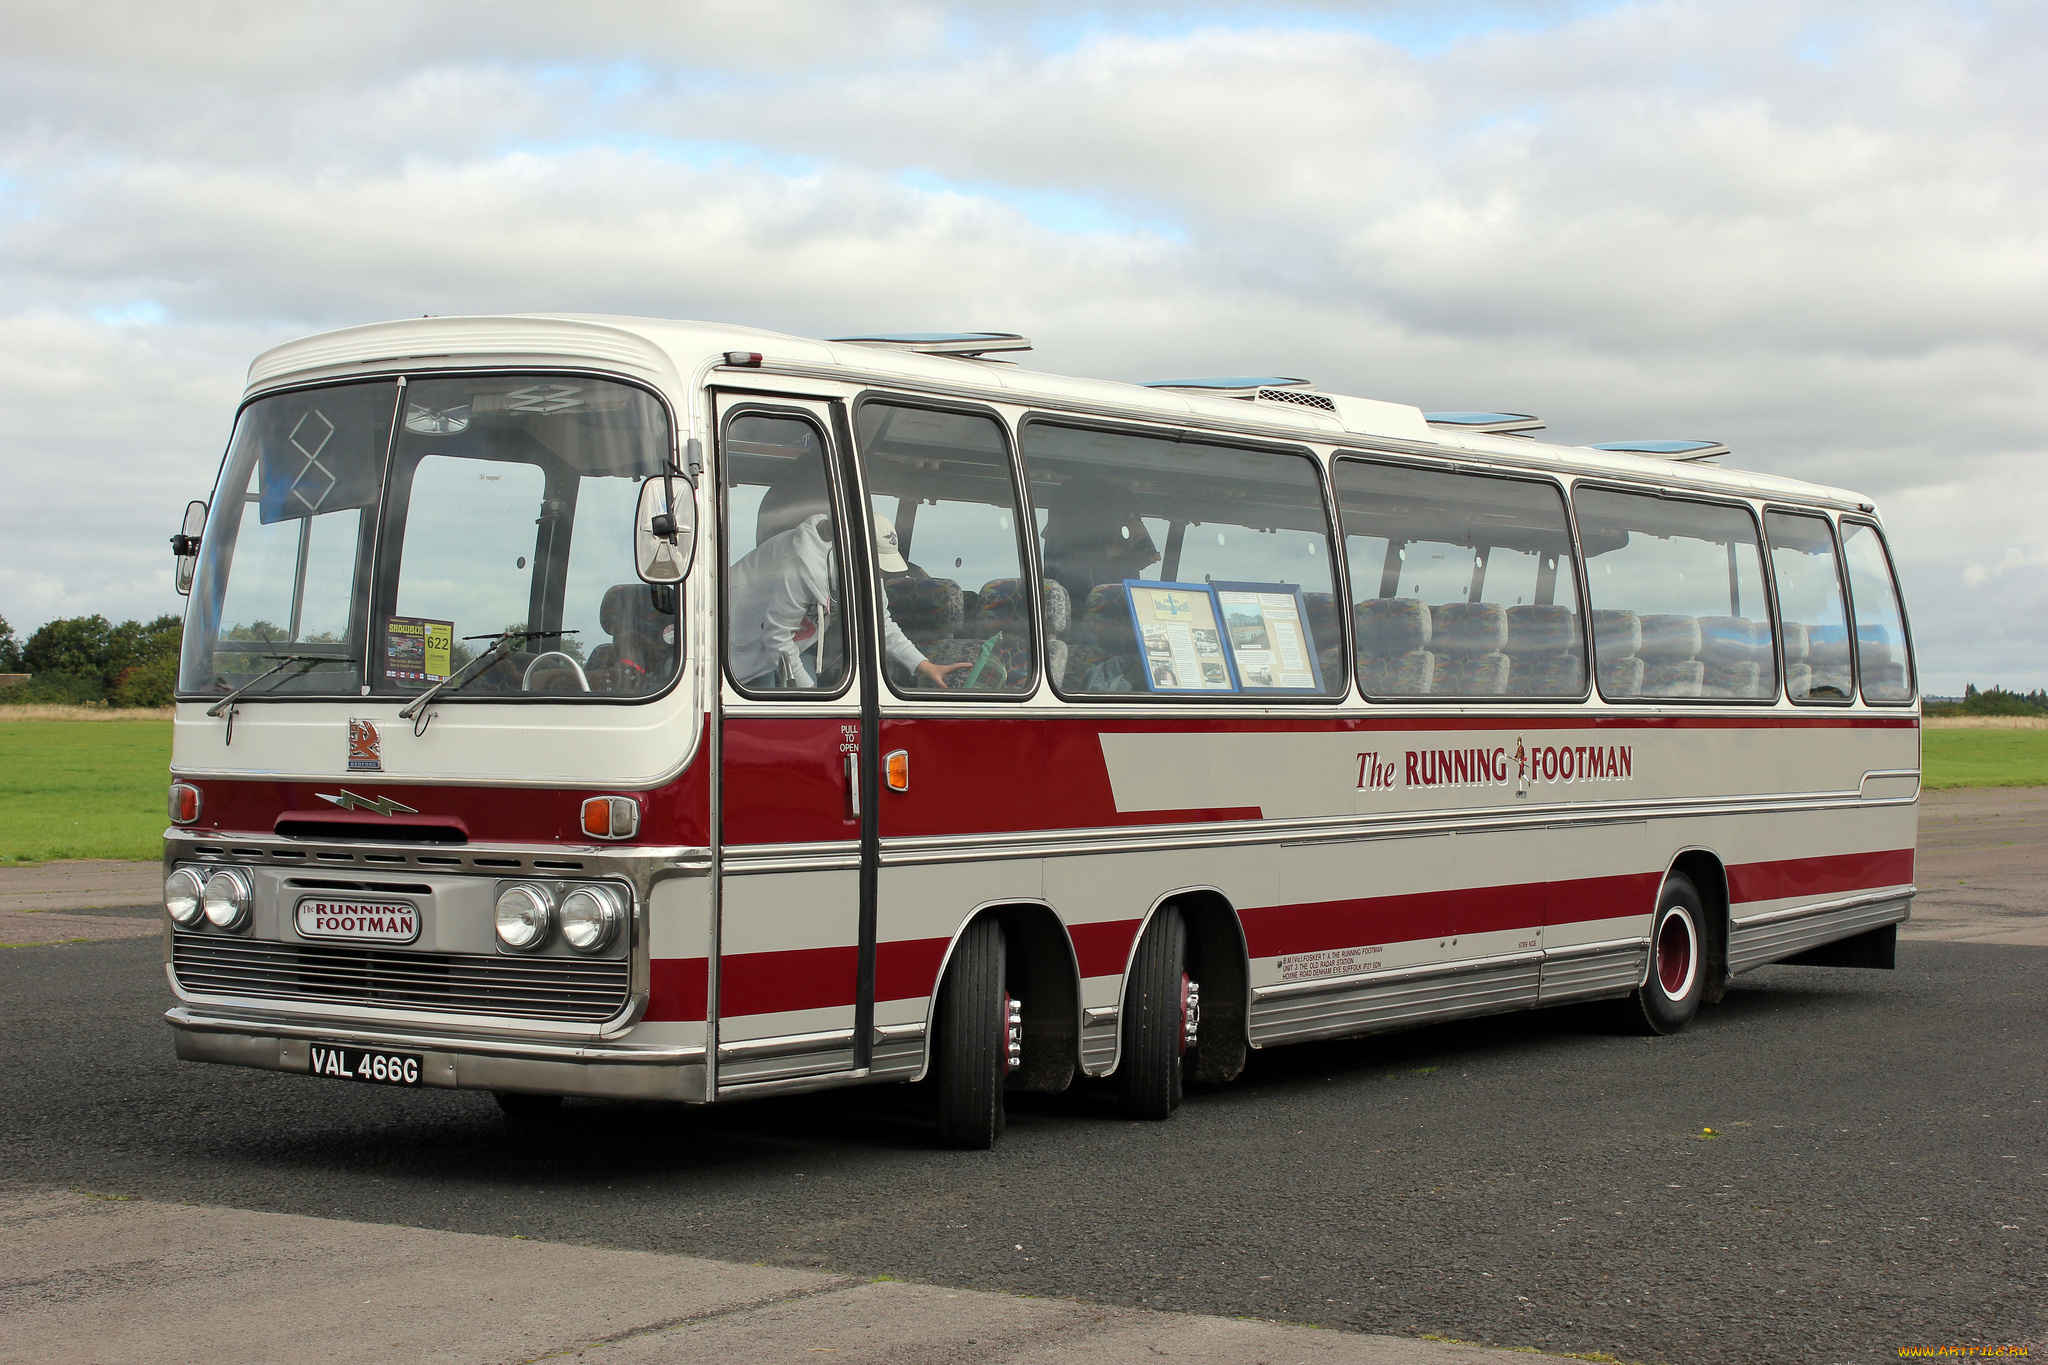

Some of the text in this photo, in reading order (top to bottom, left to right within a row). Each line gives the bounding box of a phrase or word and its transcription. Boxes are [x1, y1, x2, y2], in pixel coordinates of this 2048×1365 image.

[389, 623, 424, 634] SHOWBUS
[427, 636, 449, 651] 622
[841, 725, 858, 734] PULL
[845, 733, 855, 743] TO
[840, 743, 859, 753] OPEN
[1356, 746, 1632, 790] The RUNNING FOOTMAN
[303, 903, 412, 915] The RUNNING
[316, 916, 413, 933] FOOTMAN
[1342, 948, 1361, 957] RUNNING
[1362, 946, 1383, 955] FOOTMAN
[1283, 964, 1293, 972] UNIT
[1300, 962, 1308, 970] THE
[1310, 961, 1319, 969] OLD
[1320, 959, 1335, 968] RADAR
[1336, 957, 1355, 966] STATION
[1300, 969, 1312, 978] ROAD
[1313, 967, 1332, 976] DENHAM
[1333, 966, 1341, 974] EYE
[1342, 963, 1361, 973] SUFFOLK
[312, 1047, 418, 1083] VAL 466G
